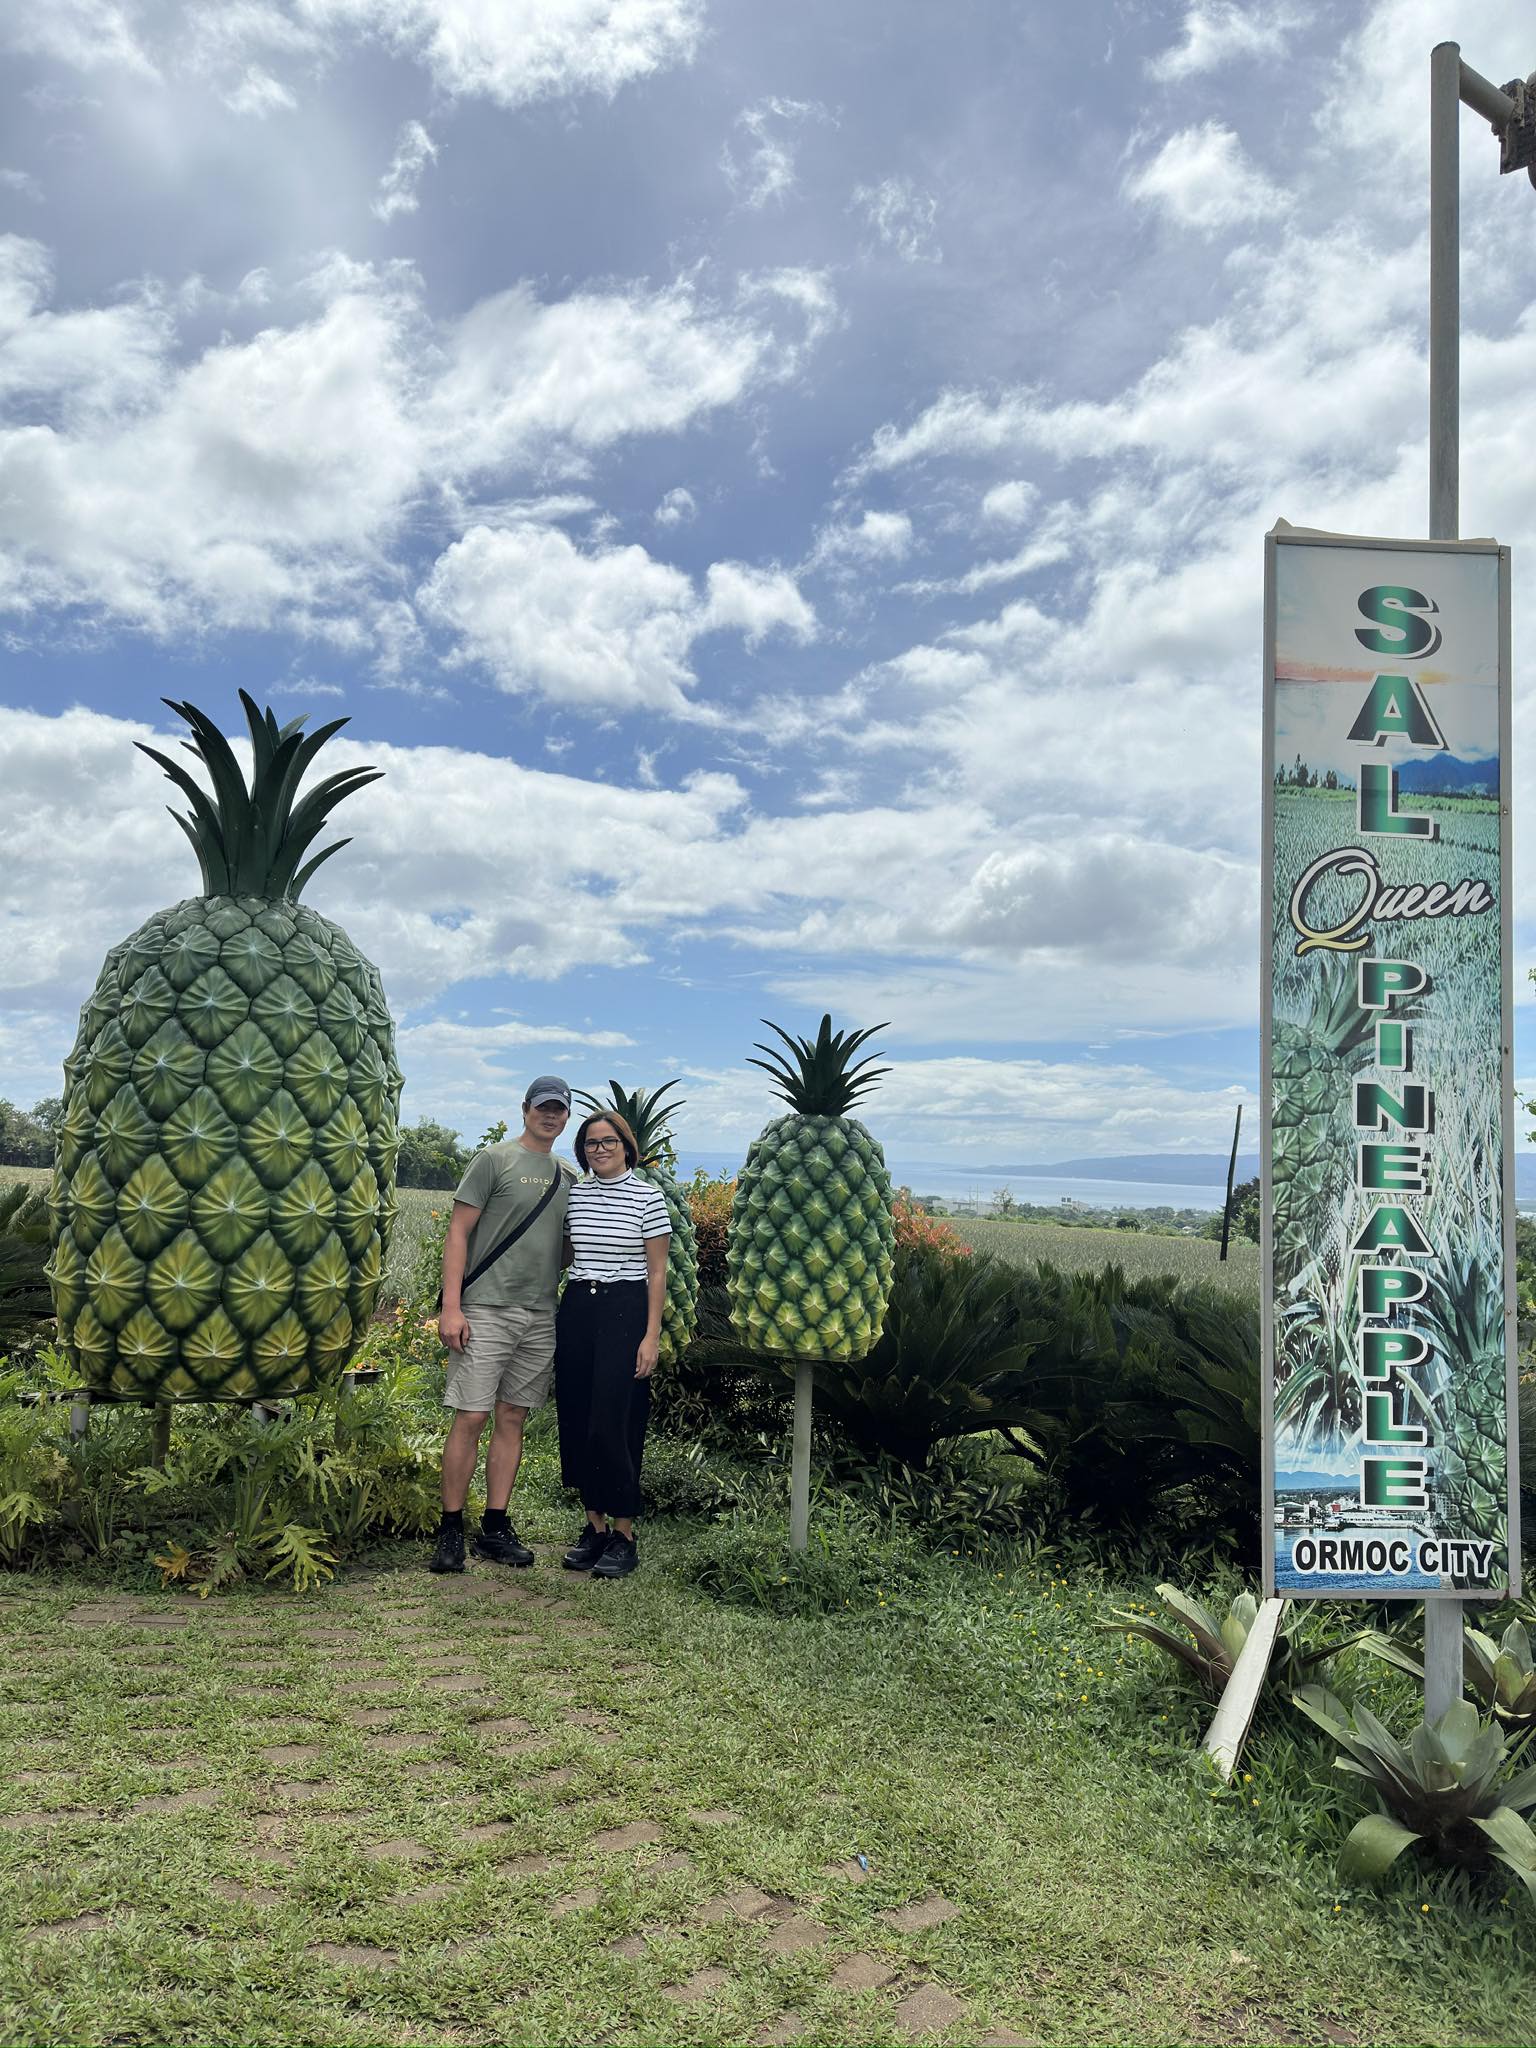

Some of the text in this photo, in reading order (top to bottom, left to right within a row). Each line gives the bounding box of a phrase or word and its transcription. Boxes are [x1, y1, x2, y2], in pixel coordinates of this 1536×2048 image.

[1347, 584, 1445, 841] SAL
[1292, 848, 1494, 955] Queen
[1352, 957, 1436, 1511] PINEAPPLE
[1294, 1538, 1493, 1576] ORMOC CITY
